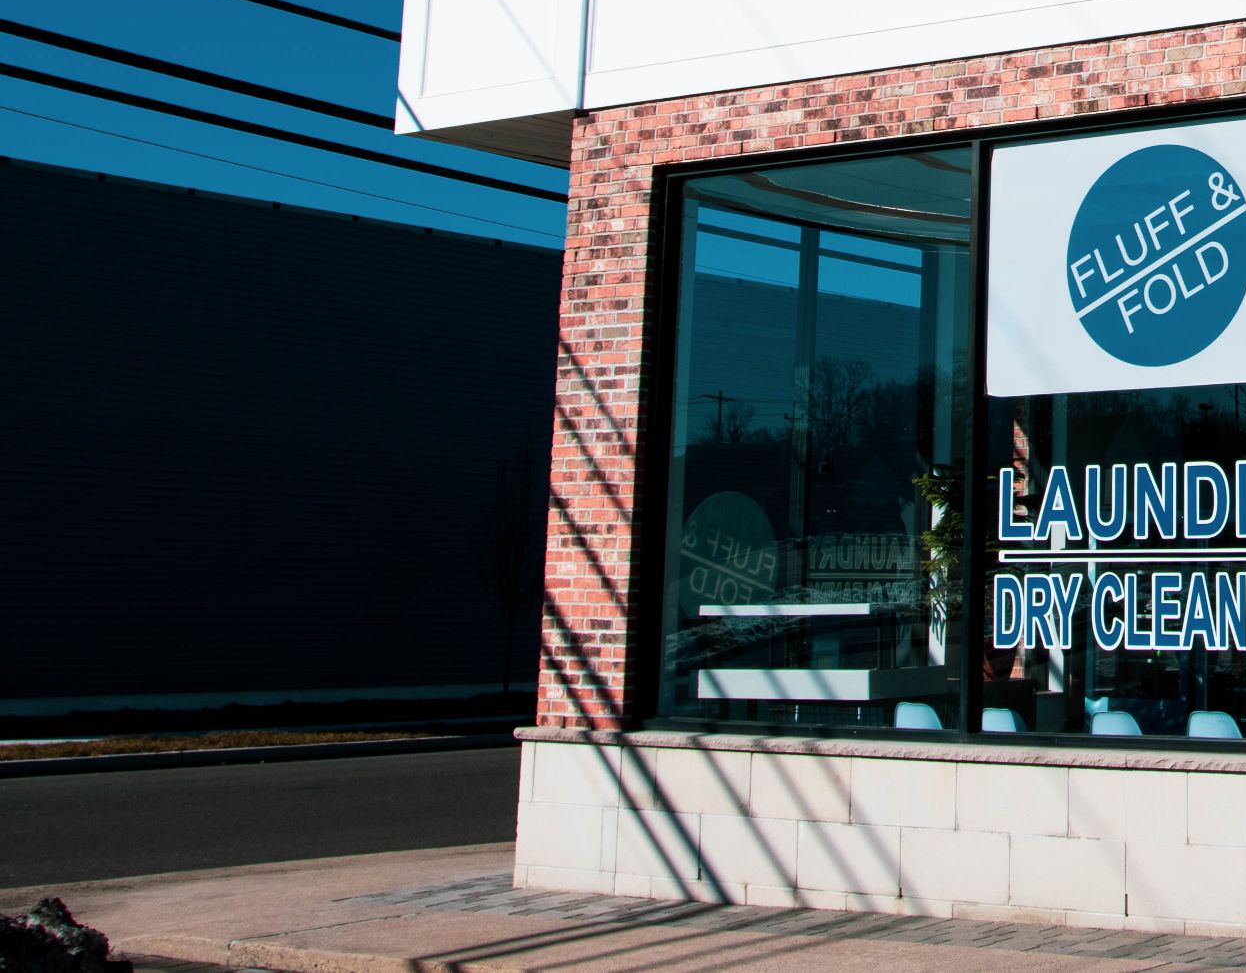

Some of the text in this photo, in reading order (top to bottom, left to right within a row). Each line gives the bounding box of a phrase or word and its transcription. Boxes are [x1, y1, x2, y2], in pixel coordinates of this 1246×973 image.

[1070, 171, 1241, 299] FLUFF &
[1116, 240, 1229, 334] FOLD
[993, 573, 1083, 650] DRY
